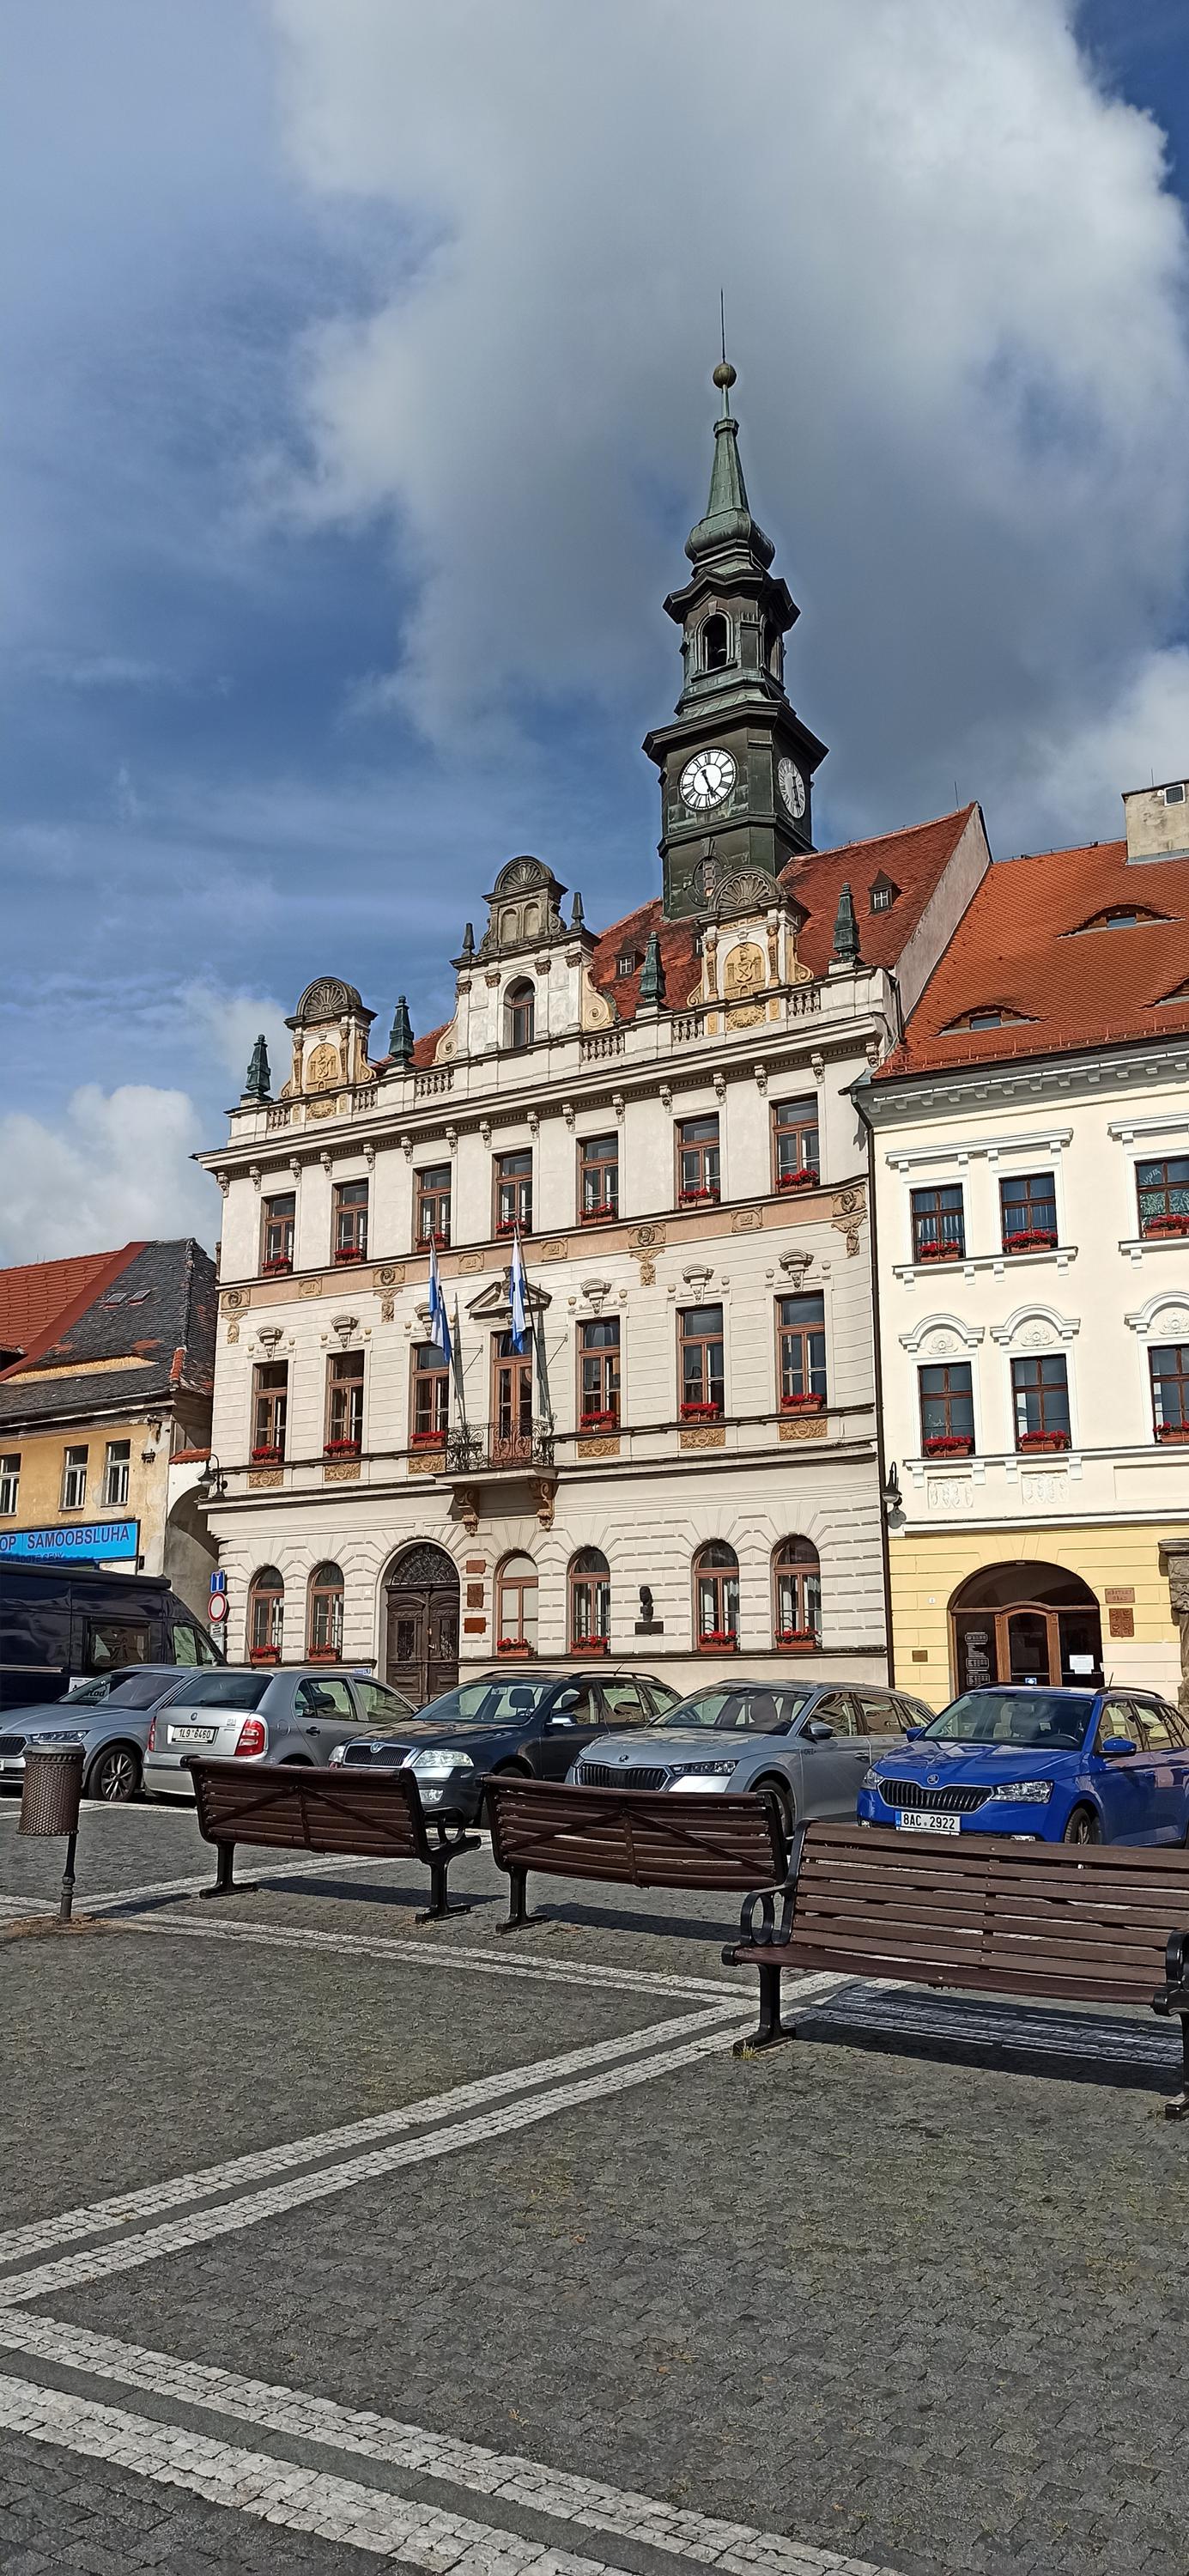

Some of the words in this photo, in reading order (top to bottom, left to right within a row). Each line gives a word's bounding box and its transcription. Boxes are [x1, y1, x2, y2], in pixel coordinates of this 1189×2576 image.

[27, 1525, 130, 1549] SAMOOBSLUHA
[903, 1814, 921, 1826] 8AC
[930, 1816, 955, 1830] 2922
